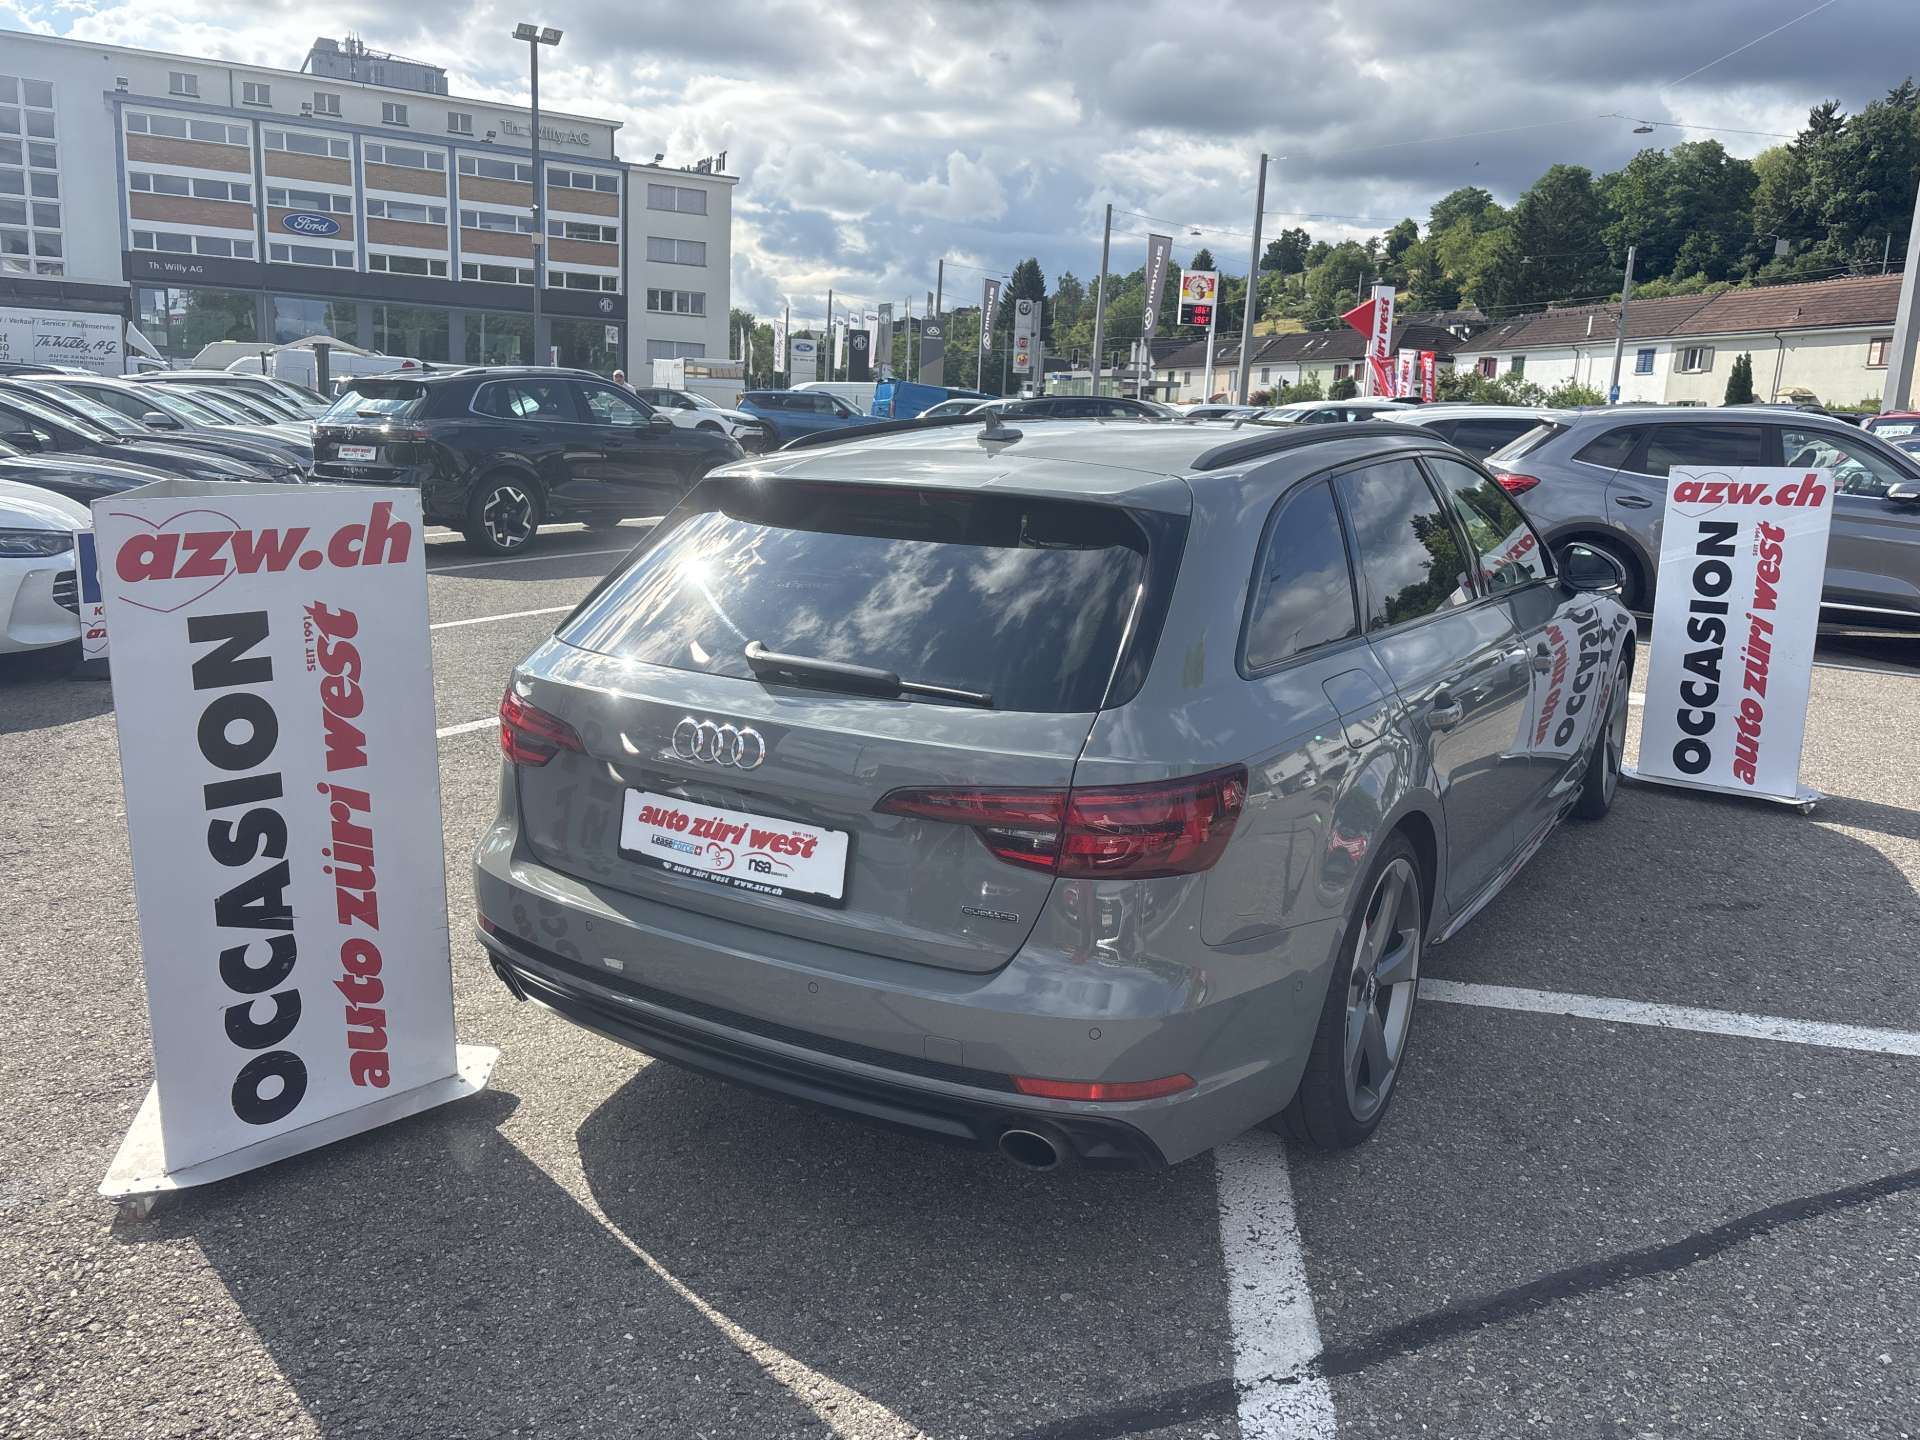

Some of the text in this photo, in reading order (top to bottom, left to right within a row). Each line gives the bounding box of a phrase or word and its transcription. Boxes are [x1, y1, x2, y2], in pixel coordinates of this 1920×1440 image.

[568, 127, 591, 146] AG
[294, 215, 329, 233] Ford
[149, 261, 203, 273] Th. Willy AG
[1379, 297, 1390, 335] west
[93, 341, 117, 354] AG
[1673, 473, 1827, 507] azw.ch
[116, 502, 412, 583] azw.ch
[303, 616, 316, 671] SEIT 1991
[1672, 521, 1738, 775] OCCASION
[1732, 520, 1785, 785] auto züri west
[303, 601, 390, 1088] auto züri west
[638, 804, 819, 859] auto züri west
[187, 610, 307, 1125] OCCASION
[672, 863, 691, 875] auto
[711, 871, 730, 884] west
[733, 878, 783, 896] www.azw.ch
[748, 858, 771, 874] nsa
